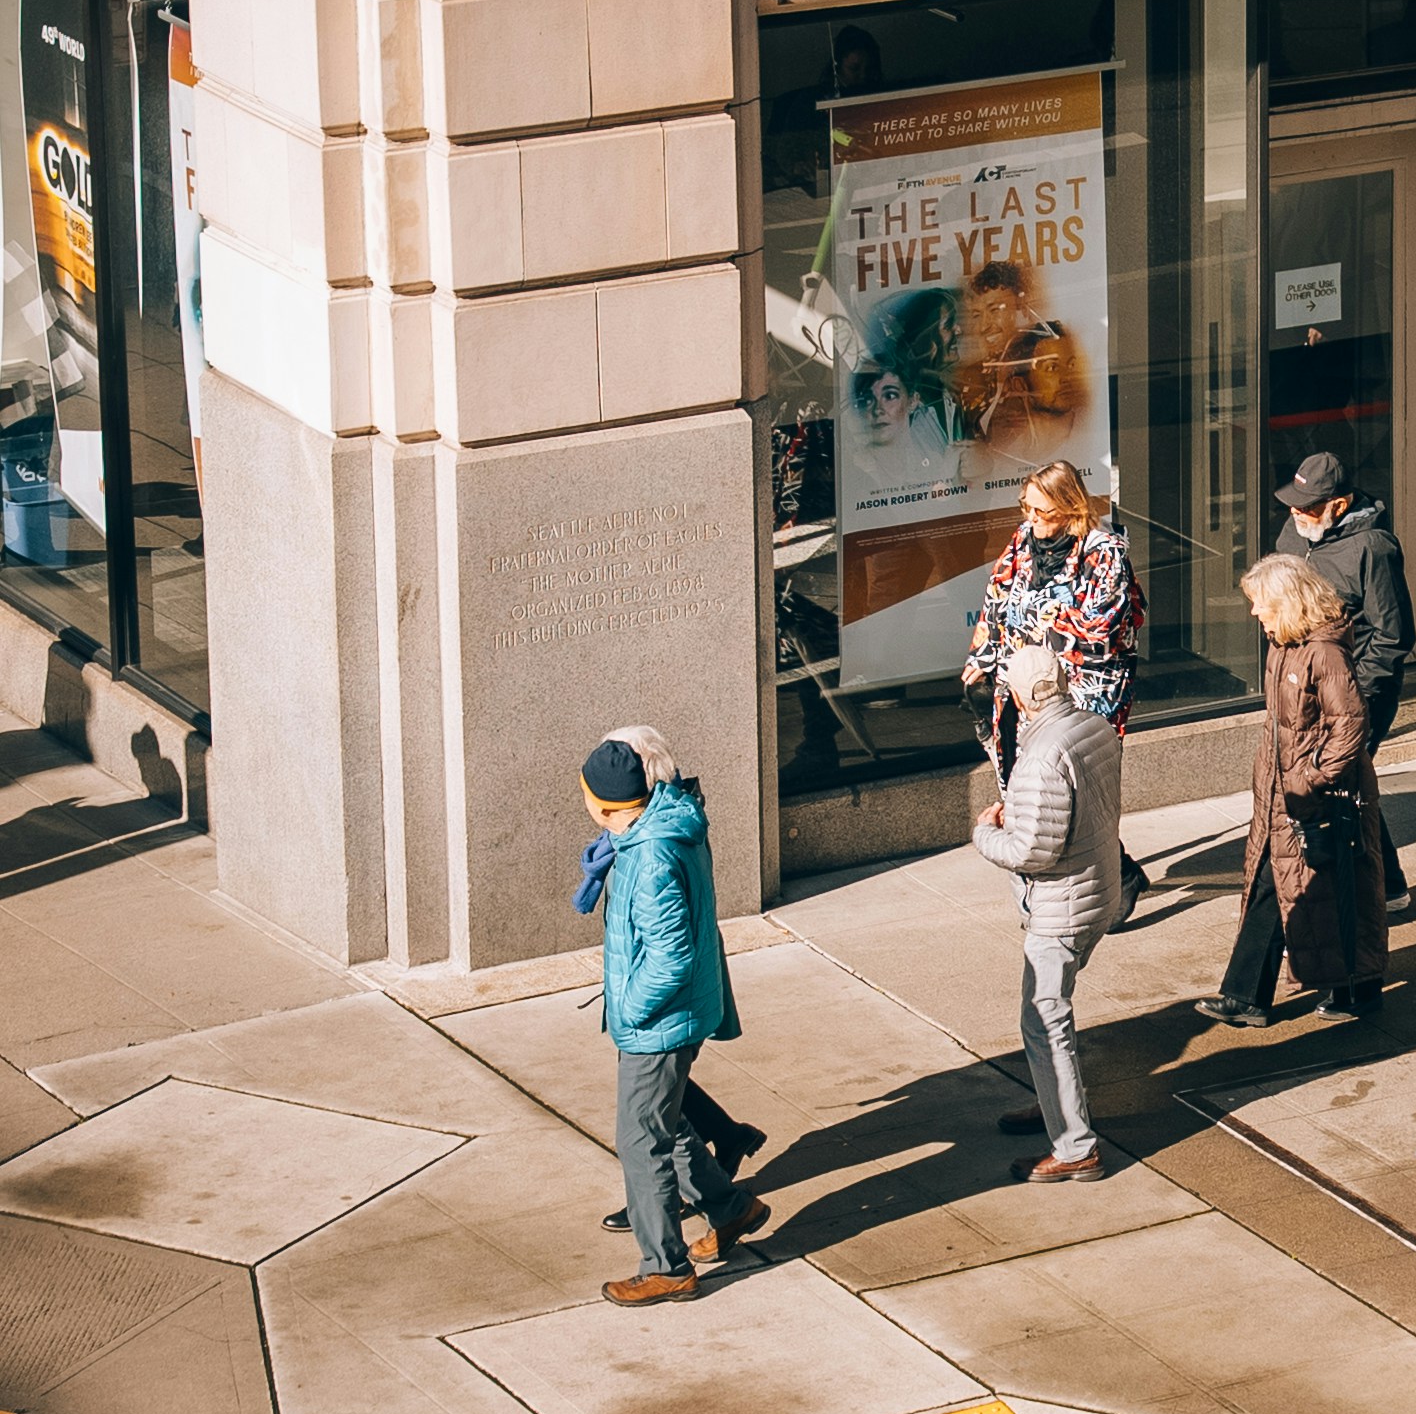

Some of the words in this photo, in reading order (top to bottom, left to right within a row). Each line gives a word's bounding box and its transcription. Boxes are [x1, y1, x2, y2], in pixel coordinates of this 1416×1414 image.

[58, 32, 85, 62] WORLD
[873, 117, 917, 133] THERE
[921, 112, 948, 127] ARE
[953, 109, 973, 122] SO
[977, 104, 1020, 119] MANY
[1023, 97, 1062, 113] LIVES
[884, 130, 922, 145] WANT
[927, 128, 943, 139] TO
[948, 121, 990, 136] SHARE
[995, 116, 1029, 130] WITH
[1034, 112, 1062, 123] YOU
[851, 198, 939, 240] THE
[970, 177, 1087, 223] LAST
[857, 235, 942, 292] FIVE
[954, 215, 1085, 276] YEARS
[855, 498, 889, 511] JASON
[890, 492, 929, 505] ROBERT
[931, 485, 968, 499] BROWN
[985, 476, 1027, 490] SHERMO
[527, 517, 595, 542] SEATTLE
[603, 509, 647, 530] AERIE
[490, 545, 575, 573] FRATERNAL
[576, 537, 633, 559] ORDER
[637, 531, 661, 550] OF
[665, 522, 723, 546] EAGLES
[566, 562, 632, 586] MOTHER
[511, 592, 607, 621] ORGANIZED
[665, 575, 705, 596] 1898
[493, 631, 527, 650] THIS
[531, 617, 605, 643] BUILDING
[608, 604, 681, 631] ERECTED
